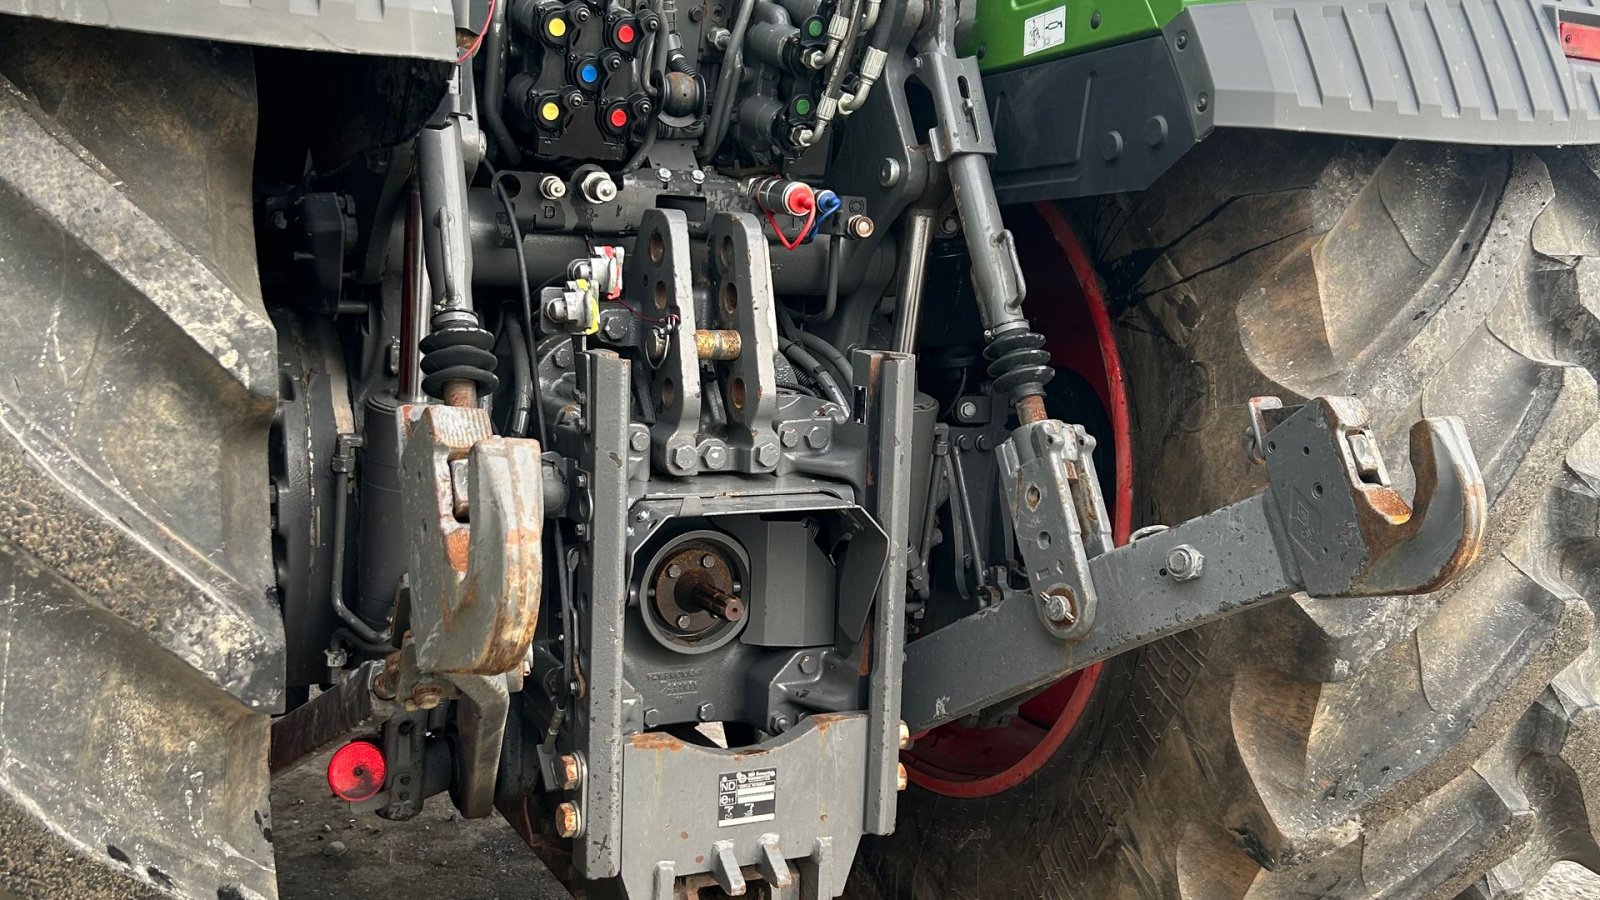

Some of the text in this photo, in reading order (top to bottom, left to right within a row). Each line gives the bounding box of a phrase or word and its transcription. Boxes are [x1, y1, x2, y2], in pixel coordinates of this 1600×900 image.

[544, 205, 556, 219] D
[721, 781, 736, 792] ND
[721, 794, 735, 805] e11
